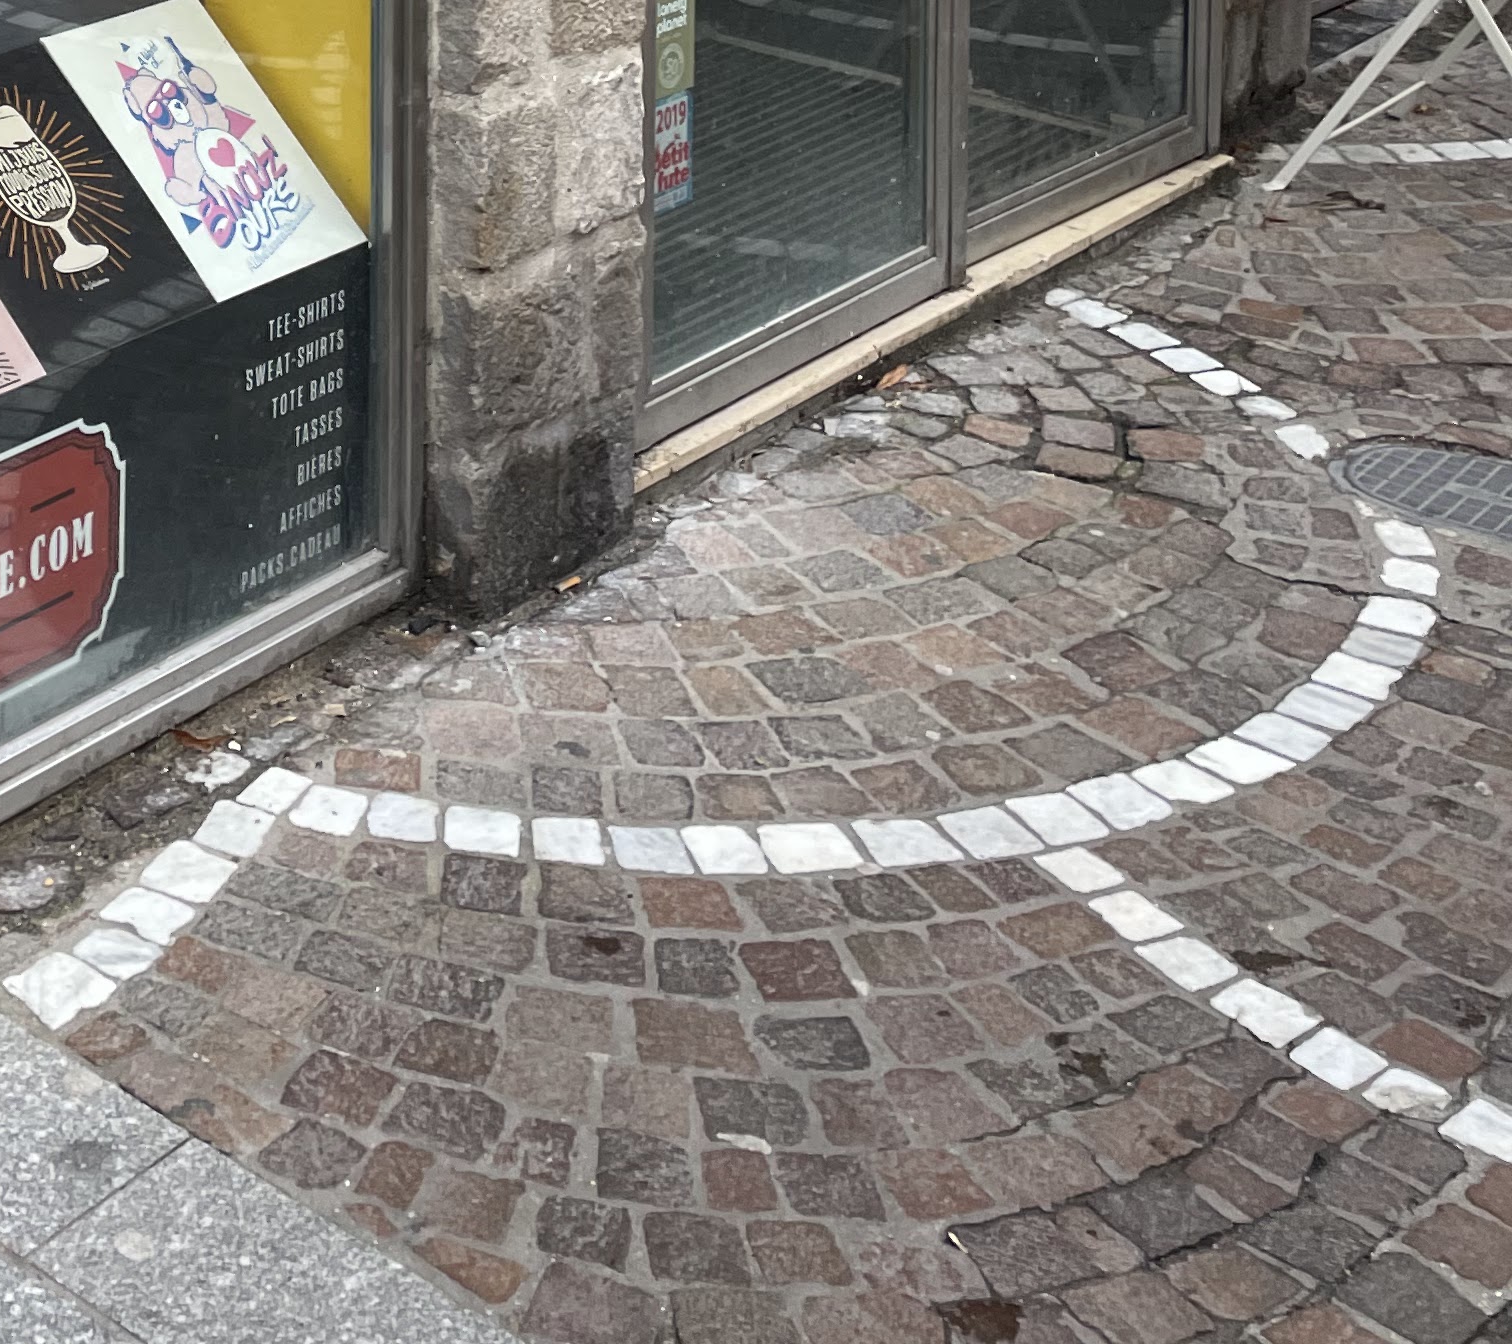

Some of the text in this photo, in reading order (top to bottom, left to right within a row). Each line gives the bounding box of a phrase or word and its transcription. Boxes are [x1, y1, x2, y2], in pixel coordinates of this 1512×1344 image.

[656, 101, 686, 134] 2019
[240, 177, 300, 251] OURS
[268, 289, 346, 342] TEE-SHIRTS
[245, 328, 345, 391] SWEAT-SHIRTS
[271, 368, 344, 419] TOTE BAGS
[294, 406, 343, 448] TASSES
[279, 484, 342, 534] AFFICHES
[240, 522, 342, 593] PACKS CADEAU
